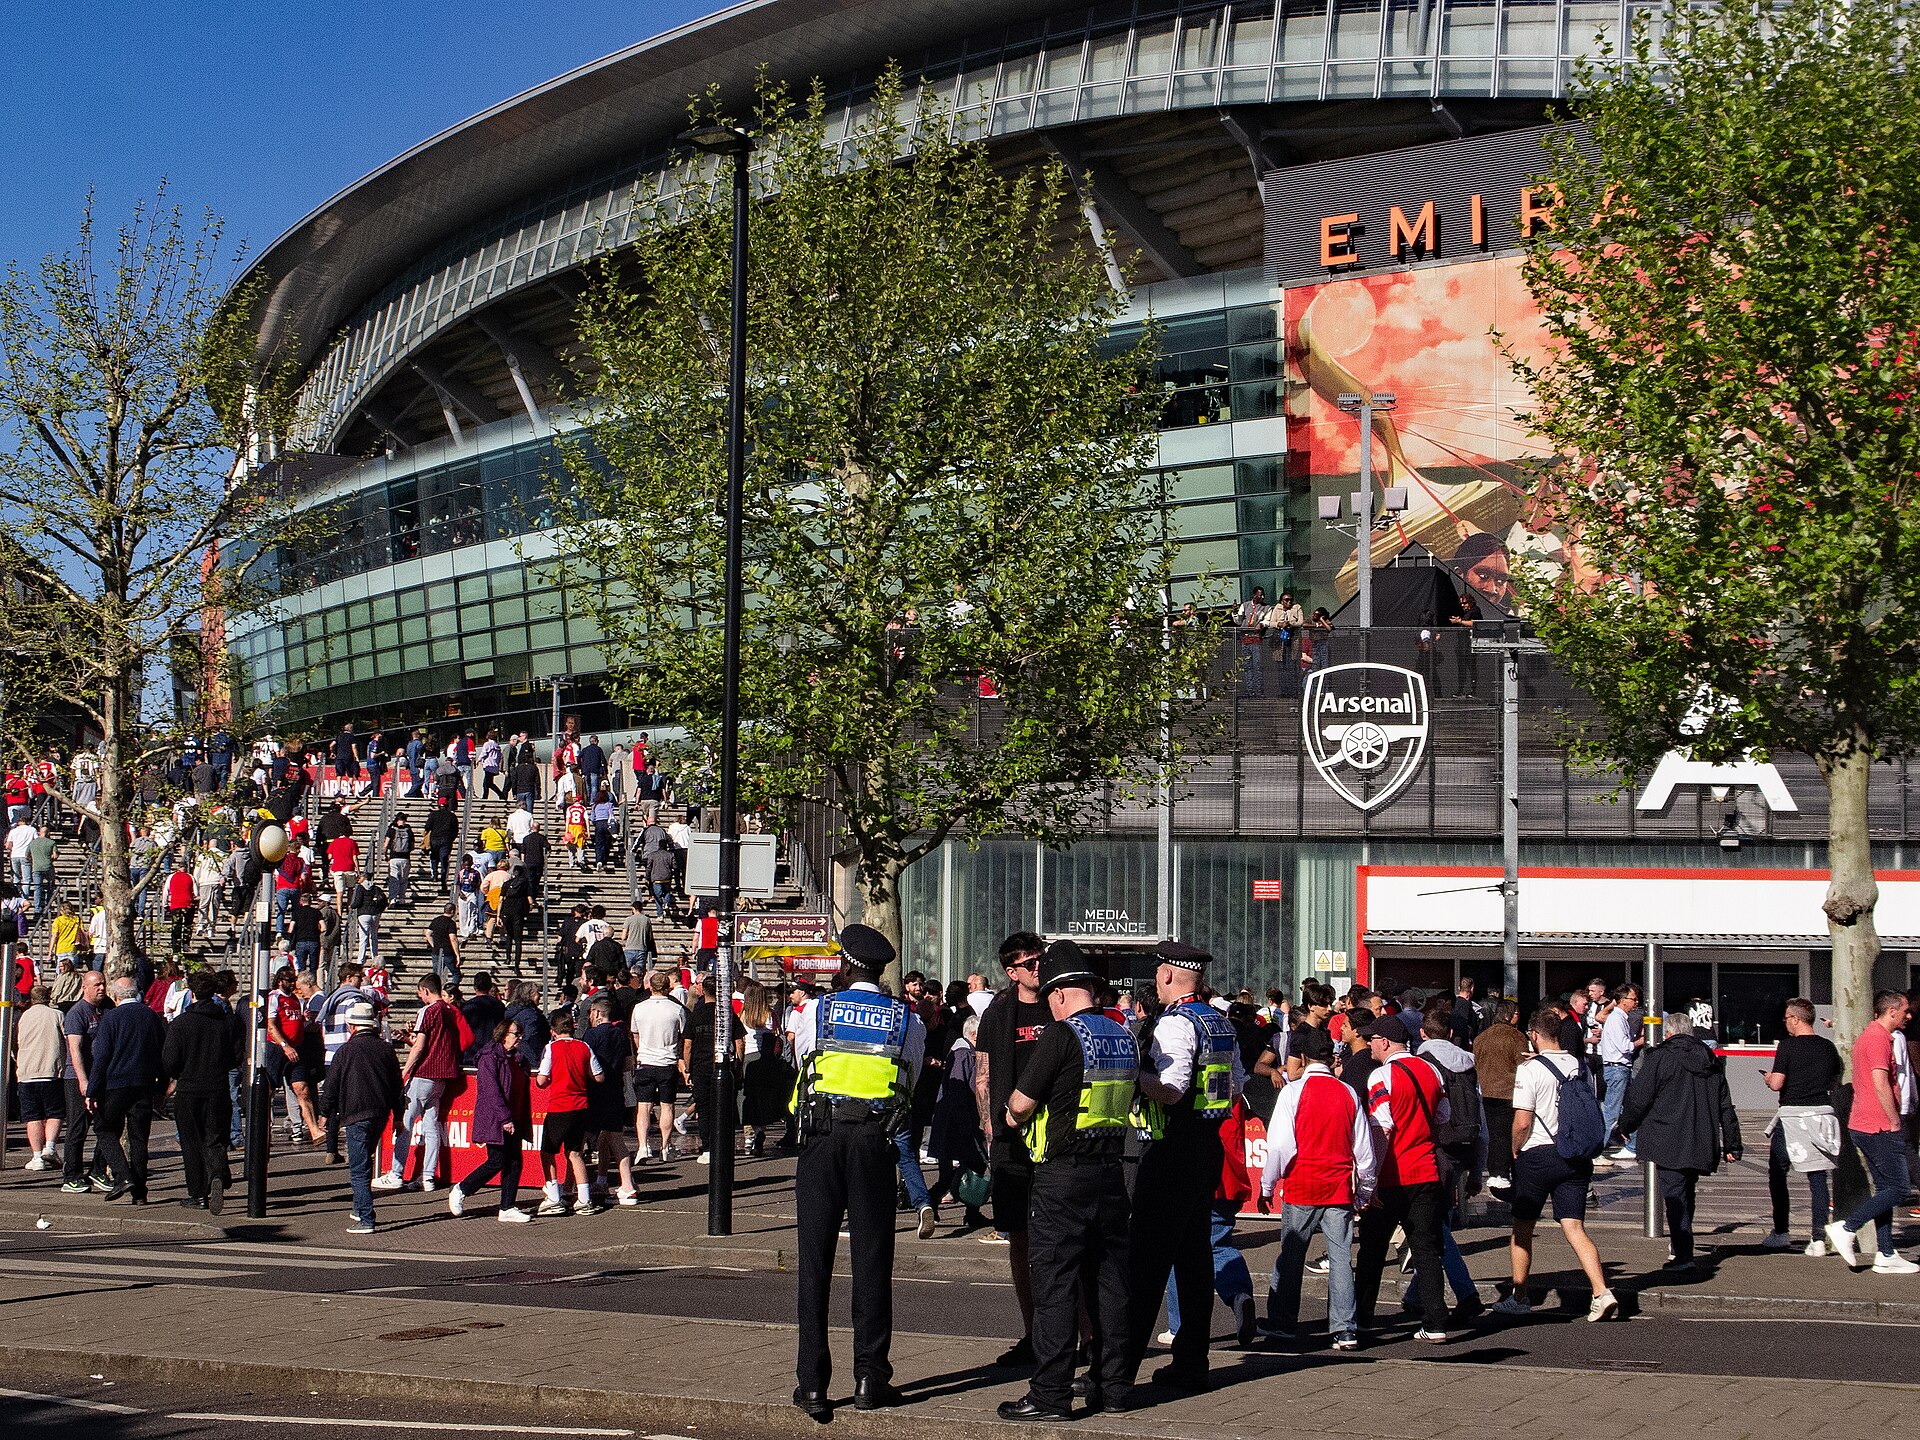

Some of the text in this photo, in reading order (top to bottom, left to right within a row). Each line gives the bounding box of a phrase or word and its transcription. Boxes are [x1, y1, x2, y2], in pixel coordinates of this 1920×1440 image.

[1320, 179, 1641, 267] EMIRA
[1320, 692, 1411, 713] Arsenal
[571, 811, 581, 824] 8
[1085, 909, 1129, 920] MEDIA
[762, 917, 816, 926] Archway Station
[1068, 921, 1147, 933] ENTRANCE
[771, 929, 790, 938] Angel
[793, 958, 841, 970] PROGRAMM
[1108, 978, 1123, 986] and
[834, 1003, 892, 1015] METROPOLITAN
[832, 1008, 891, 1028] POLICE
[1093, 1038, 1134, 1056] POLICE
